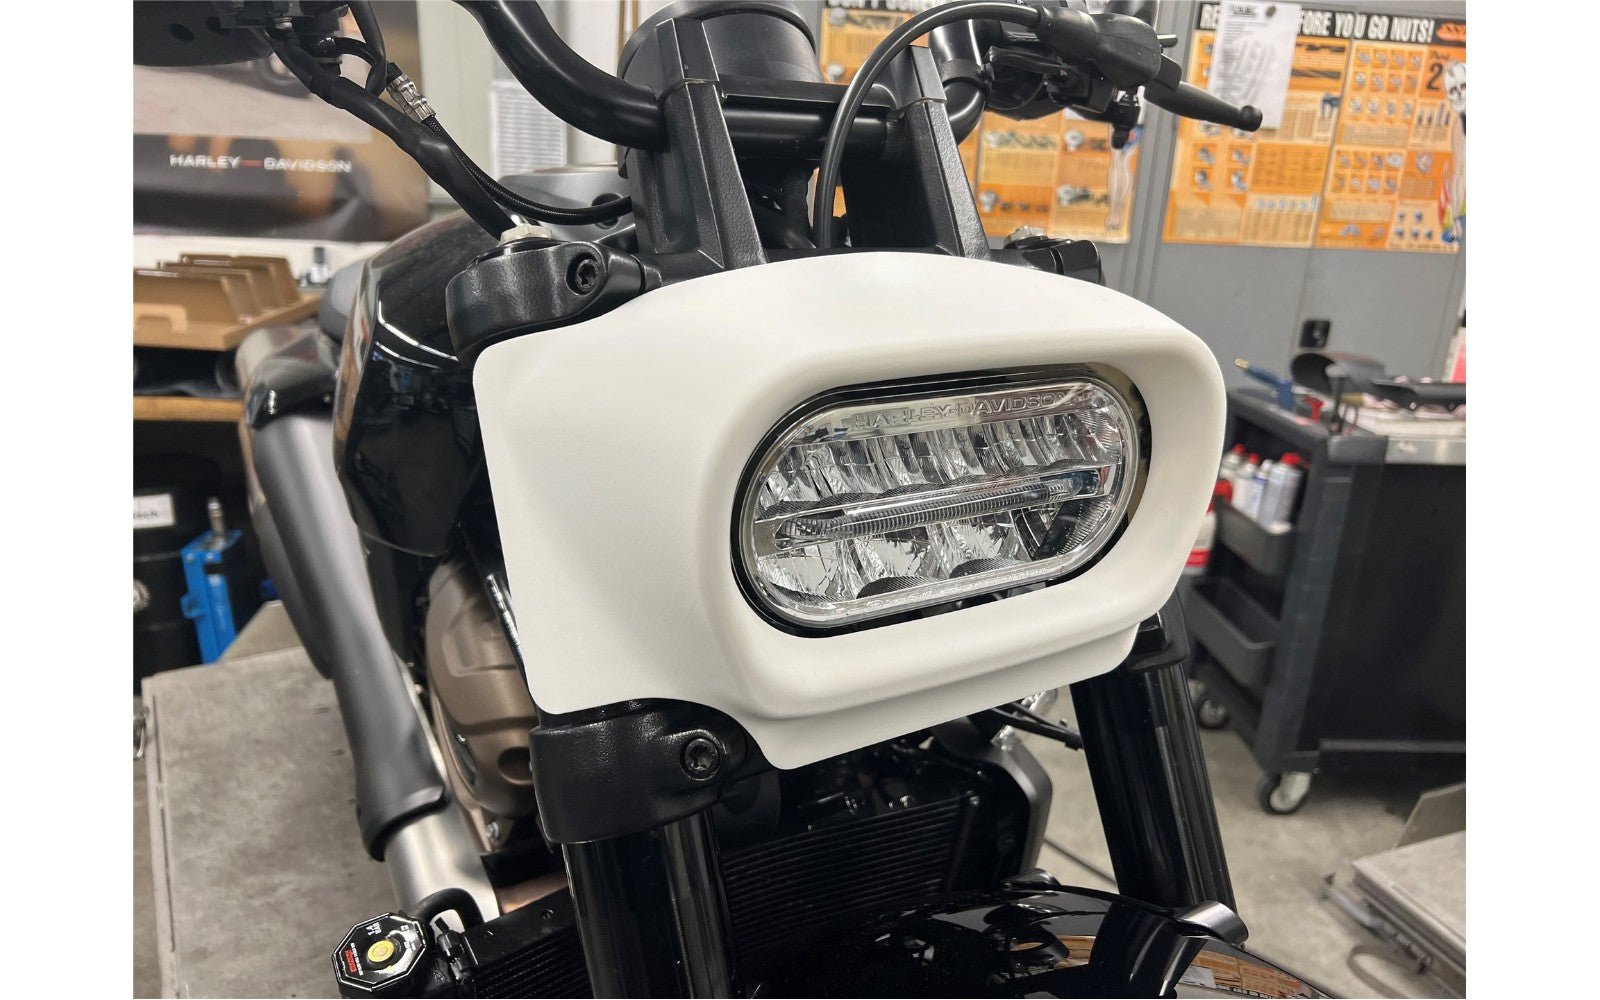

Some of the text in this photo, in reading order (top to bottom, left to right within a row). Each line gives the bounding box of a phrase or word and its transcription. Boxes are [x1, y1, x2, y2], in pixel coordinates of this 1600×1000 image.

[1335, 12, 1367, 39] YOU
[1367, 14, 1390, 40] GO
[1390, 16, 1435, 43] NUTS!
[1427, 63, 1443, 90] 2
[169, 154, 352, 173] HARLEY DAVIDSON
